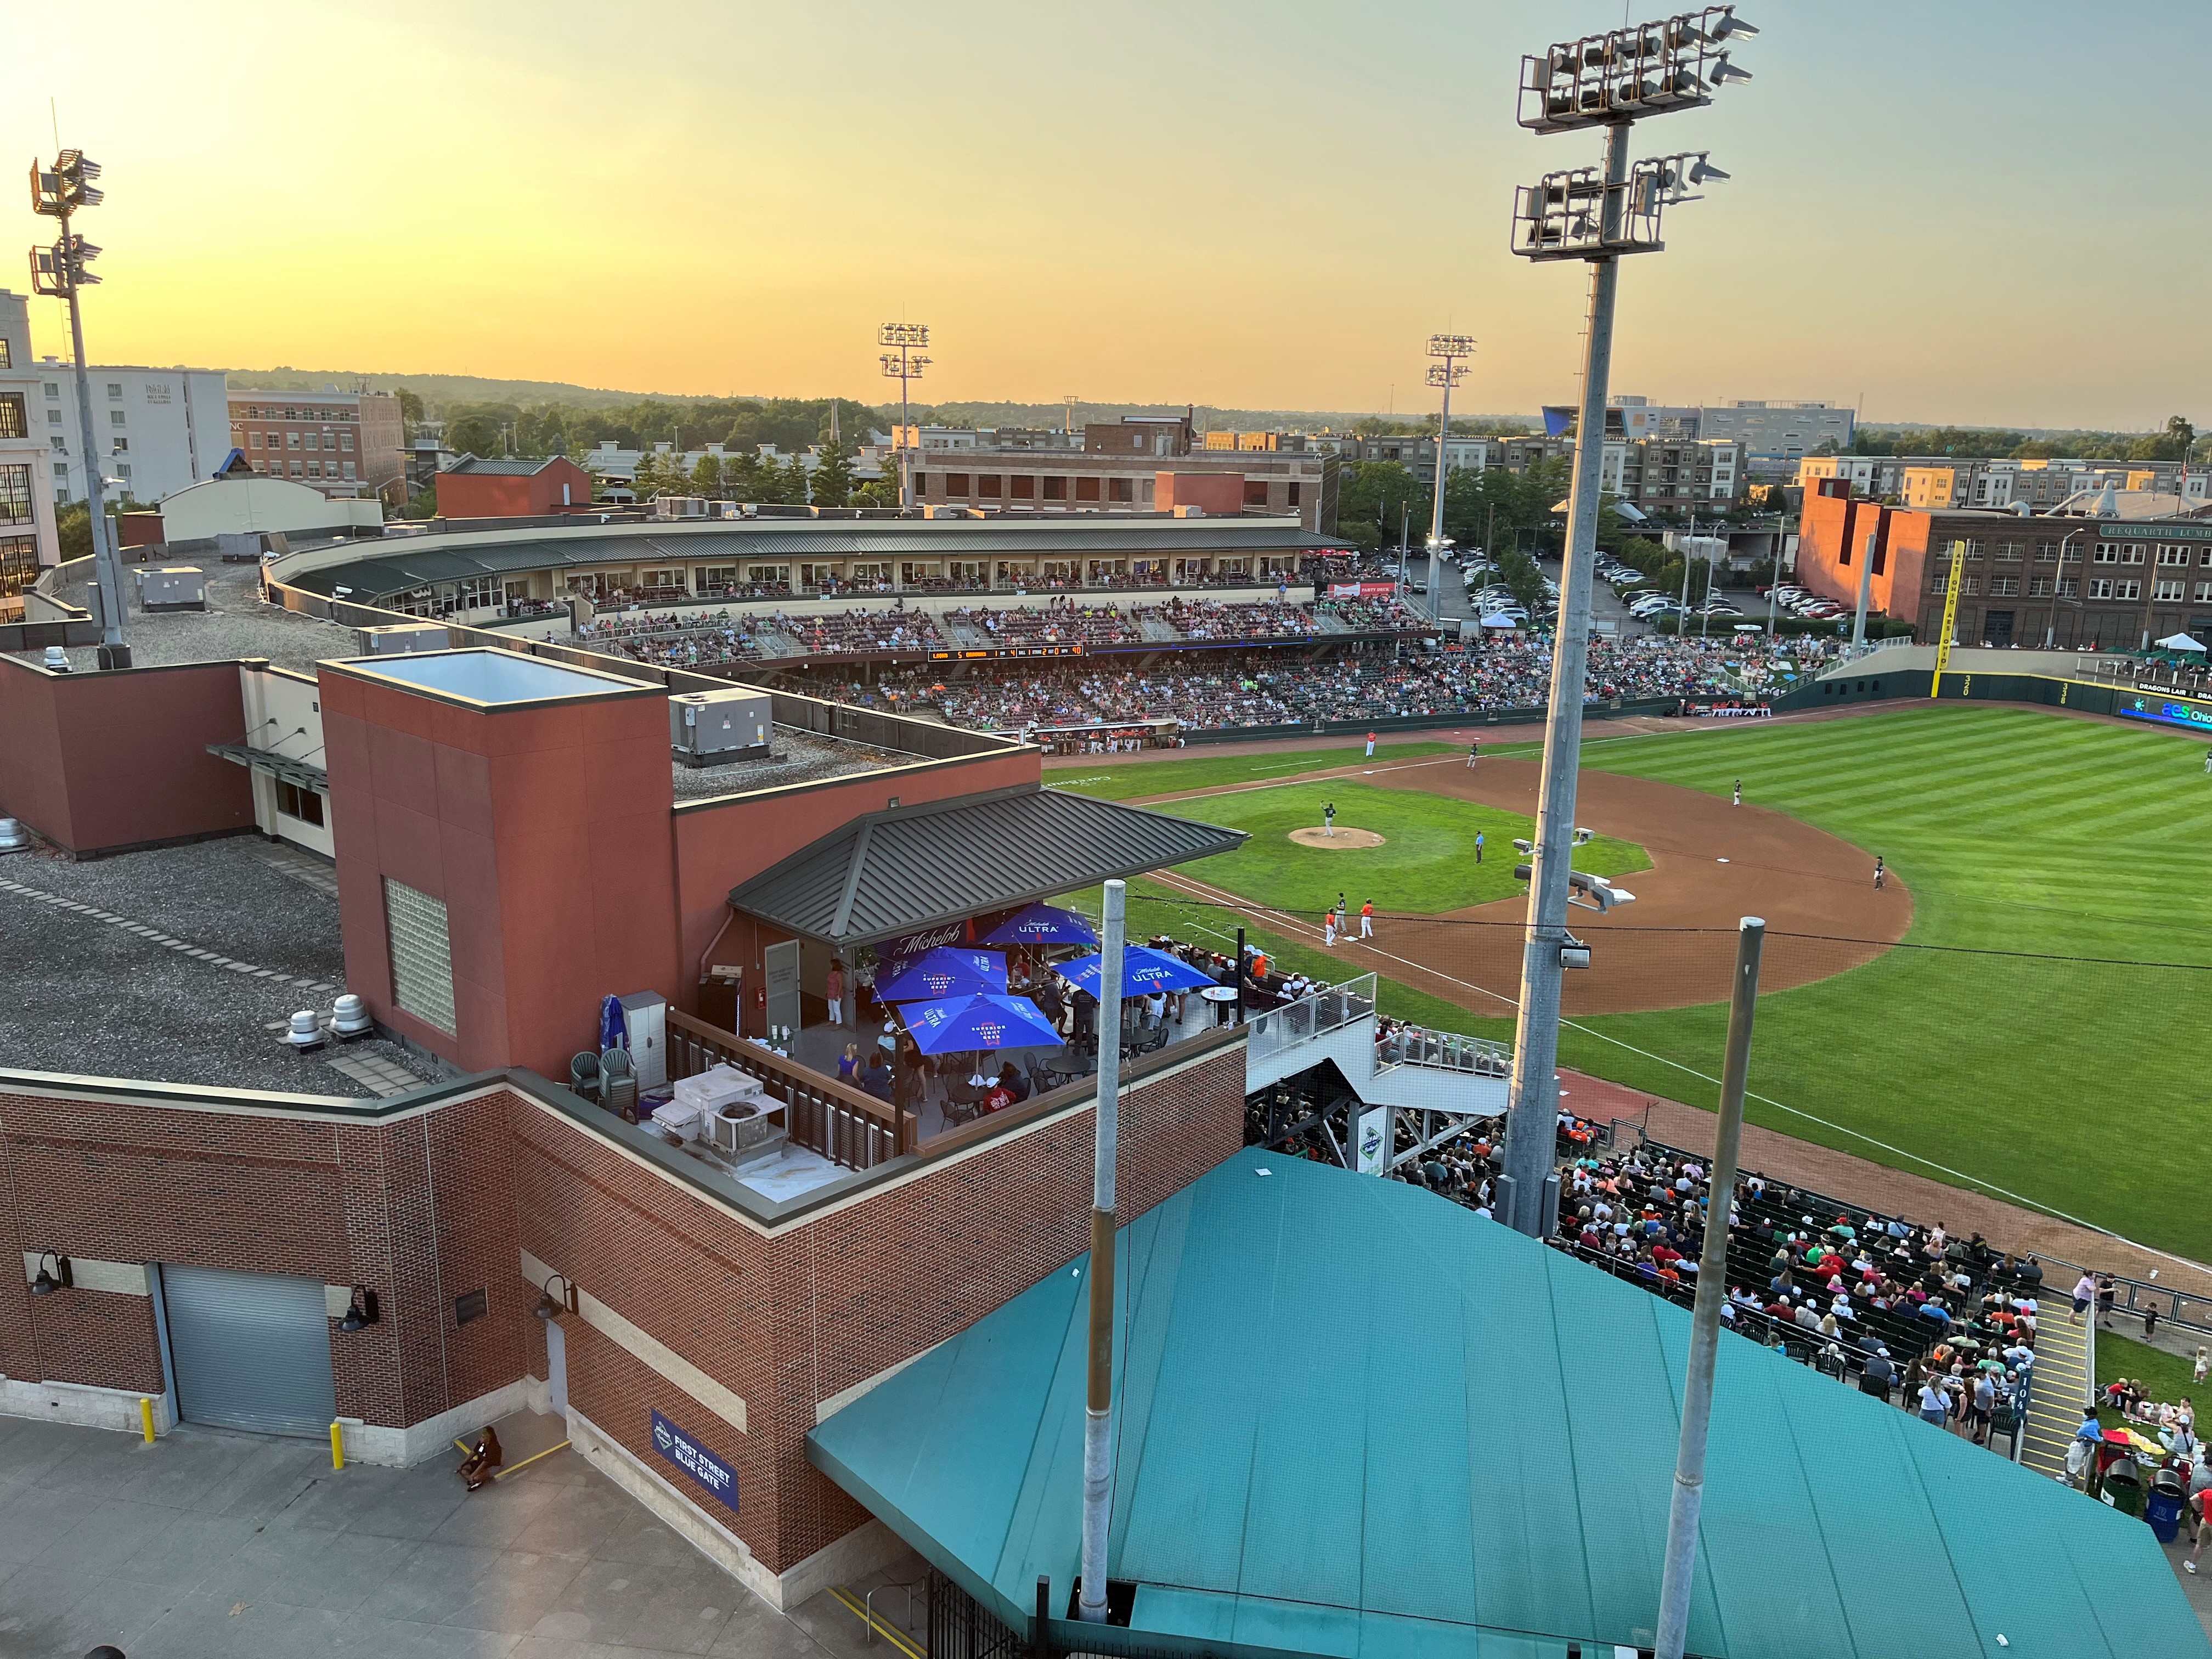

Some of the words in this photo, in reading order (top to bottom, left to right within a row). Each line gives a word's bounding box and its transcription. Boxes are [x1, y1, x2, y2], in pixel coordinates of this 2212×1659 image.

[2108, 527, 2172, 536] REQUARTH
[1949, 580, 1957, 605] OHIO
[2139, 683, 2170, 693] DRAGONS
[2162, 702, 2191, 719] aes
[893, 923, 962, 956] Michelob
[1132, 970, 1173, 982] ULTRA
[924, 1008, 941, 1028] ULTRA
[2017, 1377, 2027, 1409] 104
[674, 1435, 697, 1458] FIRST
[698, 1454, 730, 1483] STREET
[675, 1448, 696, 1472] BLUE
[697, 1466, 719, 1490] GATE
